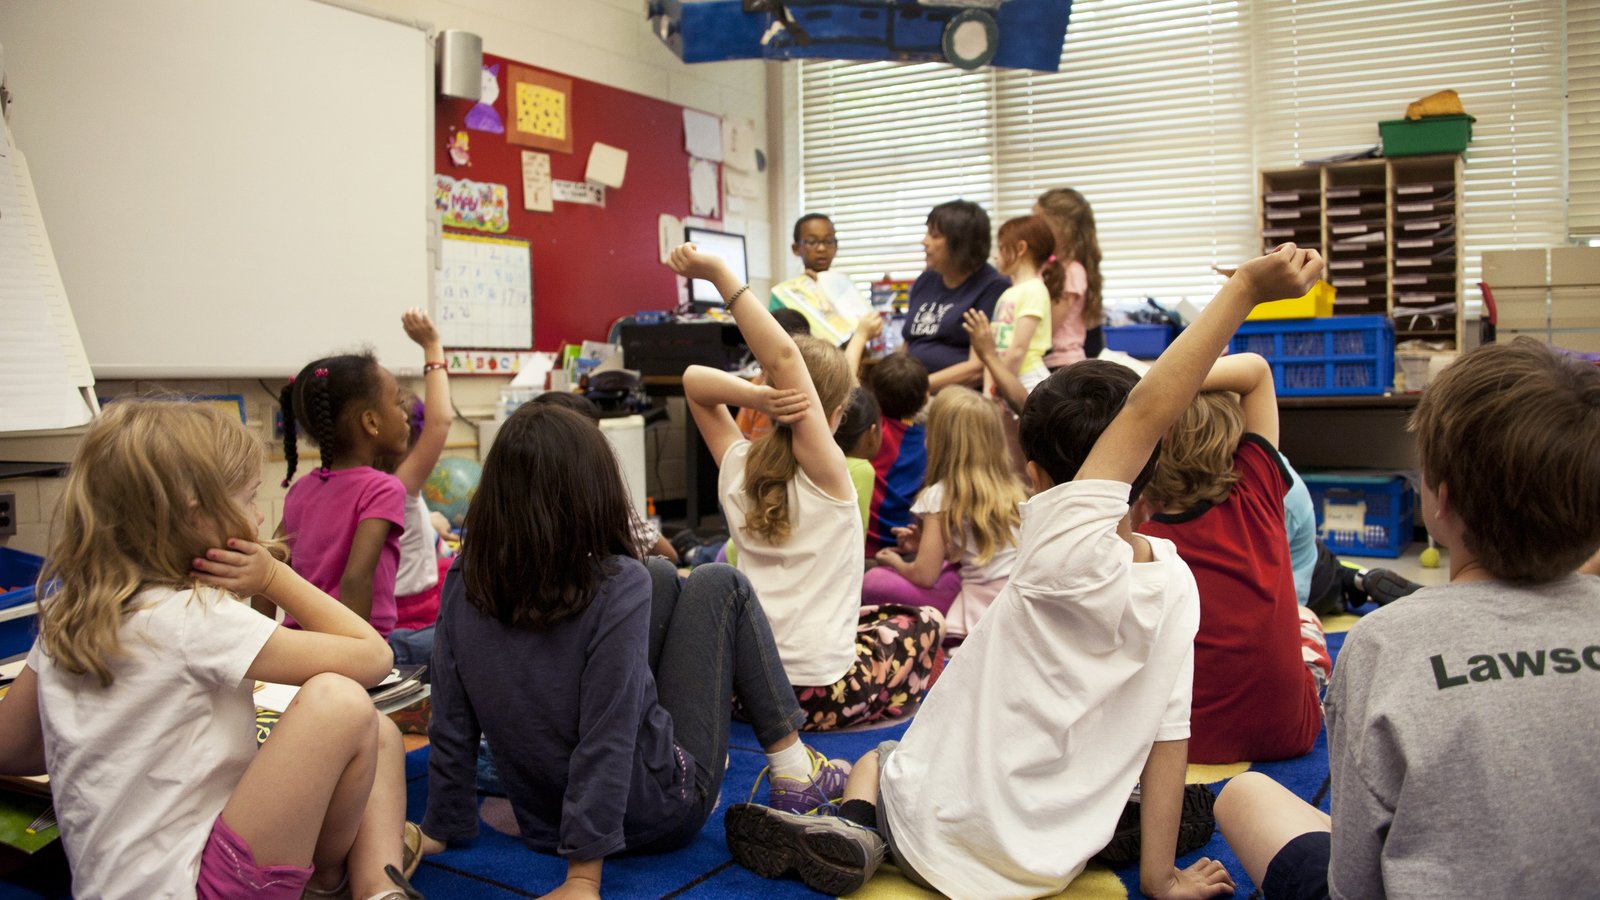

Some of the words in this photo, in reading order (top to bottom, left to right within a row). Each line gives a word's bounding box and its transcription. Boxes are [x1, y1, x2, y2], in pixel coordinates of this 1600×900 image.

[451, 192, 479, 212] MAY
[451, 356, 462, 369] A
[501, 357, 510, 369] C
